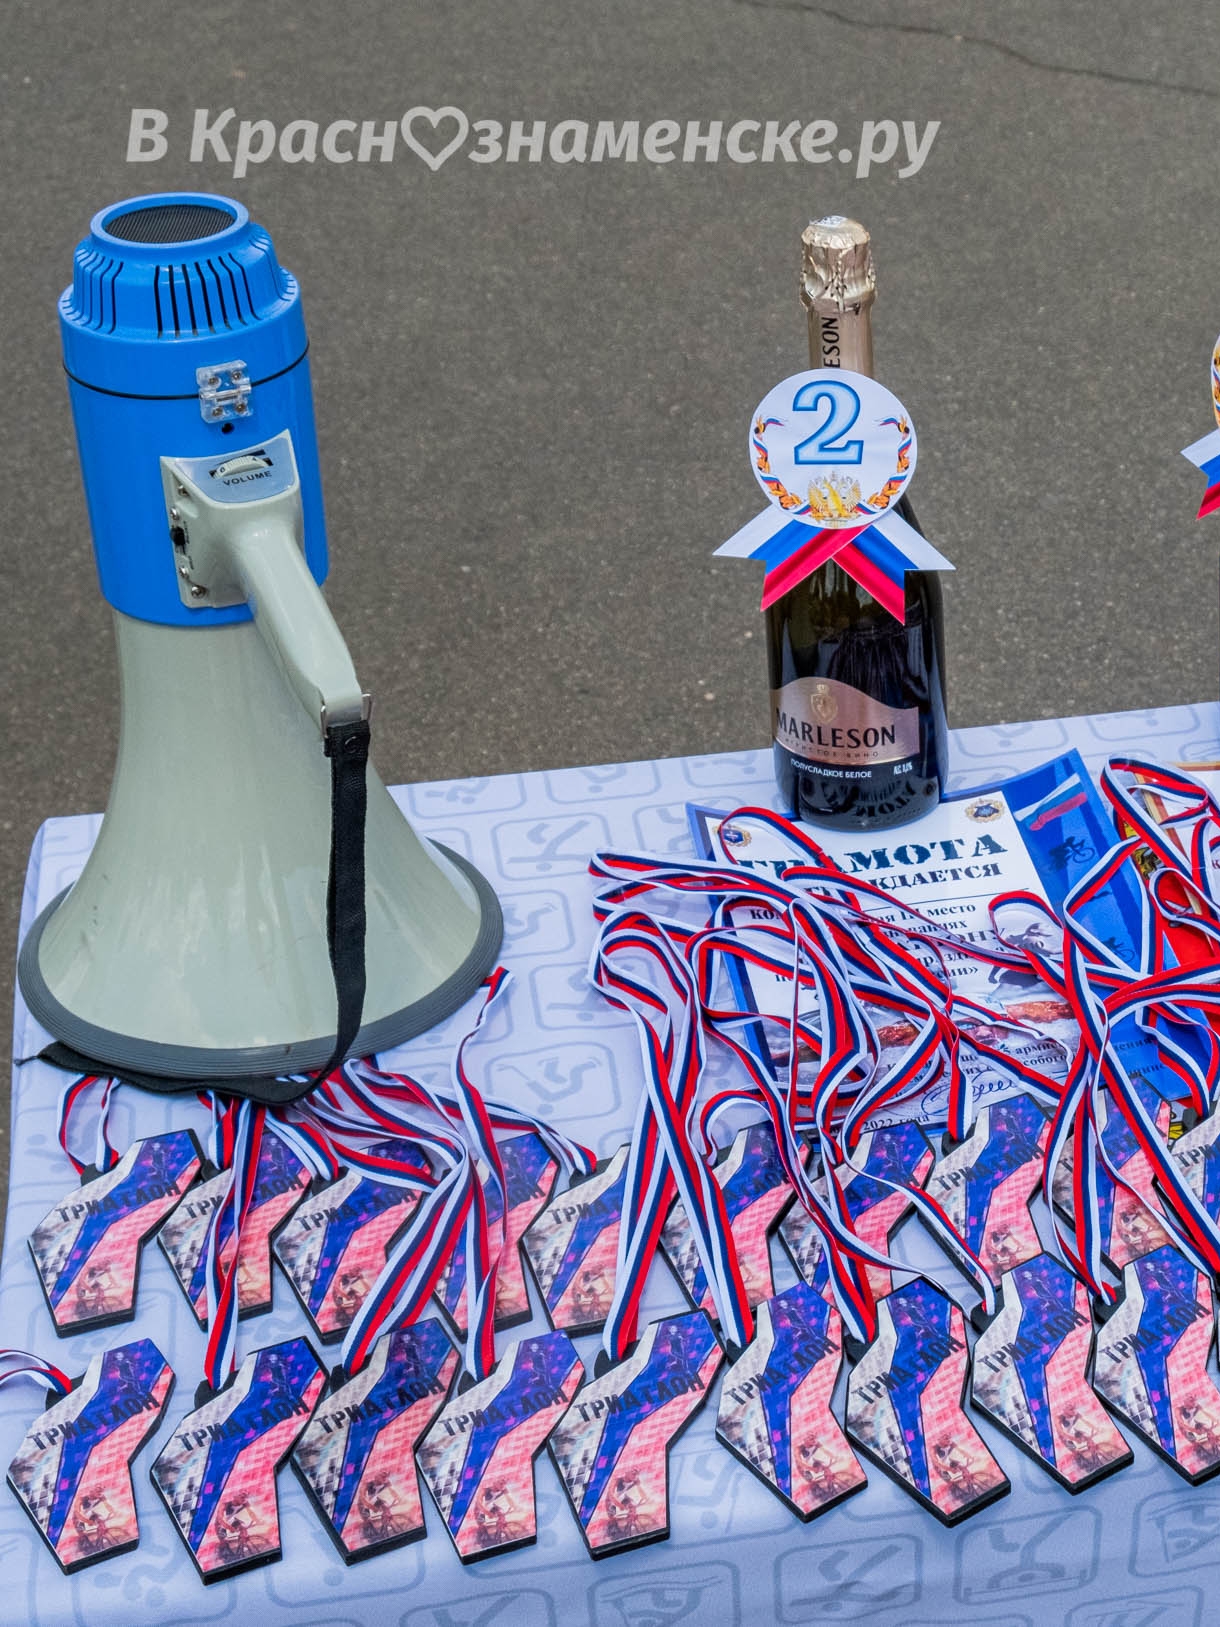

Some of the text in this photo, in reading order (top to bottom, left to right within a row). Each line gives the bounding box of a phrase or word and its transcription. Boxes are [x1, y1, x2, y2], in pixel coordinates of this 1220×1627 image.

[822, 316, 841, 369] ESON
[792, 379, 864, 465] 2
[223, 470, 272, 486] VOLUME
[776, 707, 896, 749] MARLESON
[790, 758, 873, 779] ПОЛУСЛАДКОЕ БЕЛОЕ
[927, 903, 976, 917] место
[55, 1180, 182, 1223] ТРИАТЛОН
[977, 1308, 1090, 1374] ТРИАТЛОН
[1099, 1300, 1213, 1364] ТРИАТЛОН
[574, 1371, 707, 1424] ТРИАТЛОН
[724, 1334, 841, 1406] ТРИАТЛОН
[851, 1335, 966, 1405] ТРИАТЛОН
[27, 1391, 161, 1451] ТРИАТЛОН
[175, 1395, 311, 1452] ТРИАТЛОН
[313, 1377, 447, 1435] ТРИАТЛОН
[437, 1386, 570, 1437] ТРИАТЛОН
